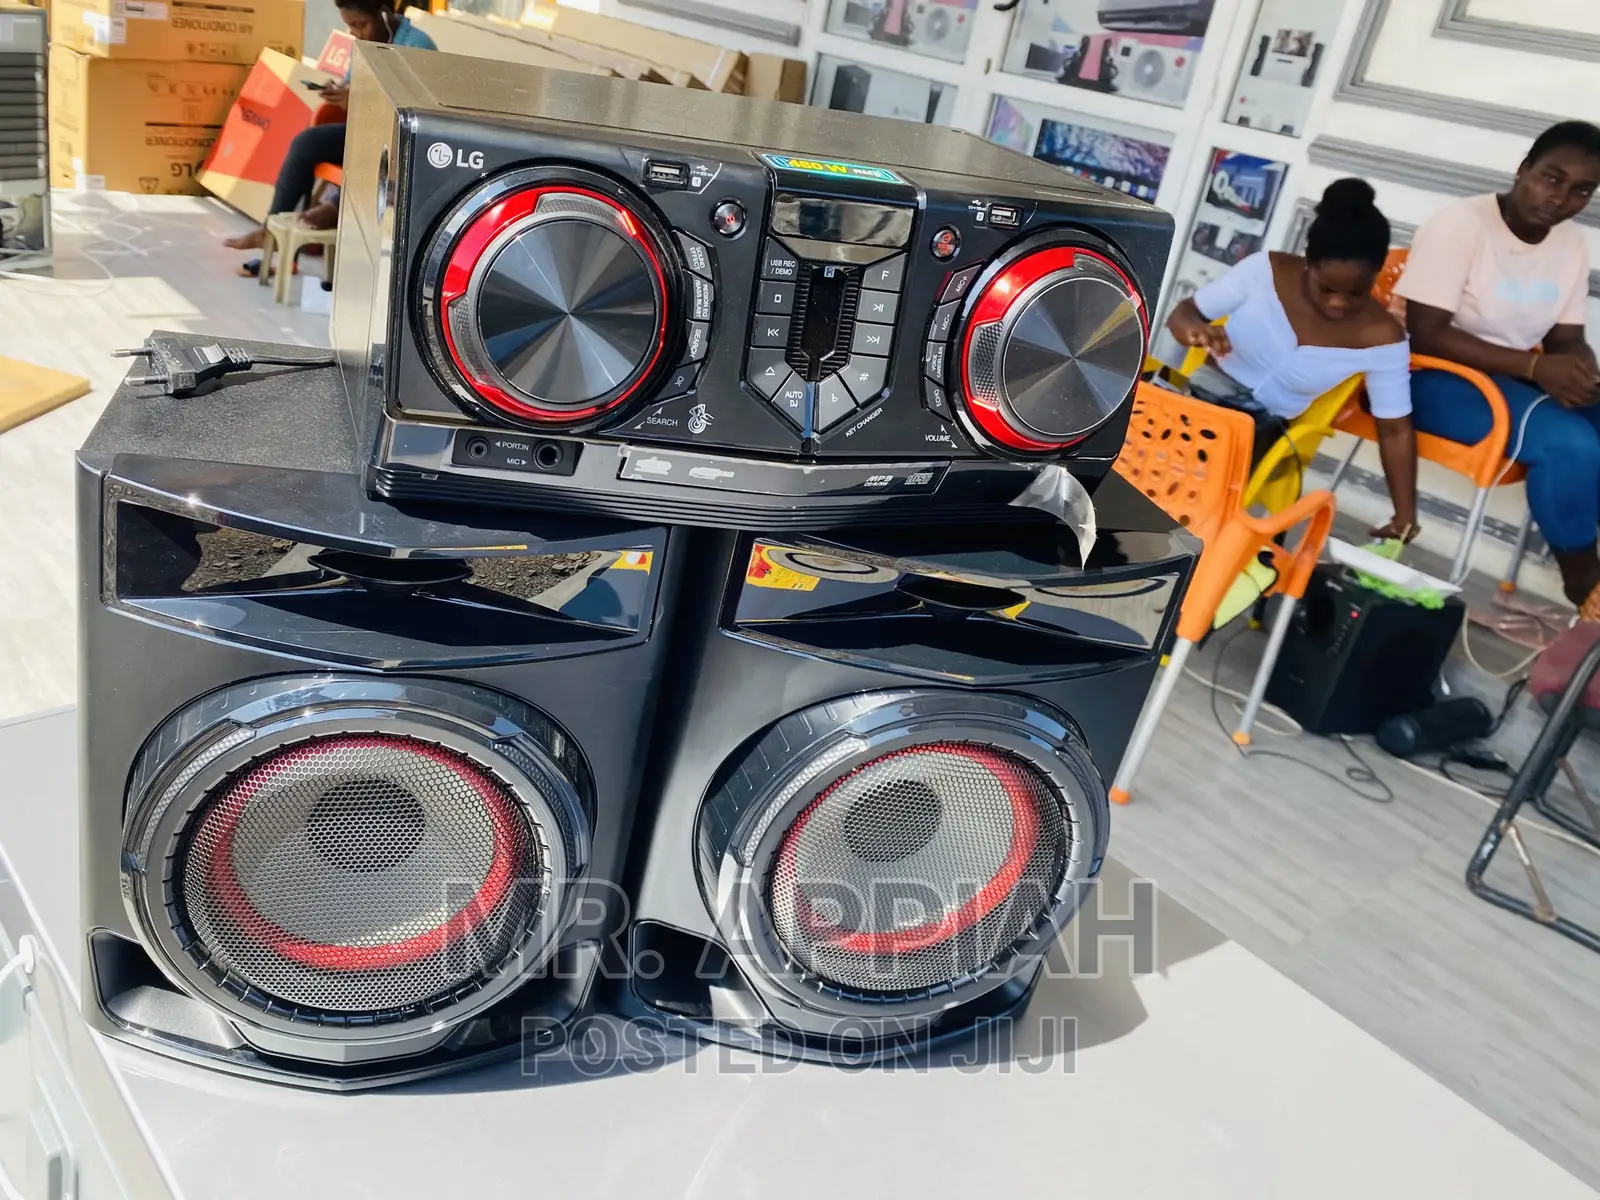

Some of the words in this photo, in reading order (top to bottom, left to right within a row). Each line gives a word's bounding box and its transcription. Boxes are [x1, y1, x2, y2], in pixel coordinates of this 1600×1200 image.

[172, 16, 237, 33] CONDITIONER
[238, 19, 254, 34] AIR
[326, 44, 348, 68] LG
[456, 148, 484, 169] LG
[170, 161, 193, 177] LG
[690, 246, 701, 270] EFFECT
[696, 246, 706, 269] SOUND
[770, 259, 782, 267] USB
[881, 270, 890, 280] F
[694, 299, 702, 318] BLAST
[689, 328, 702, 358] SEARCH
[936, 346, 944, 379] CANCELLER
[674, 375, 685, 387] OK
[784, 390, 803, 399] AUTO
[933, 389, 942, 408] ECHO
[789, 399, 798, 408] DJ
[646, 416, 678, 427] SEARCH
[845, 424, 857, 437] KEY
[856, 407, 883, 429] CHANGER
[925, 434, 951, 442] VOLUME
[506, 456, 521, 465] MIC
